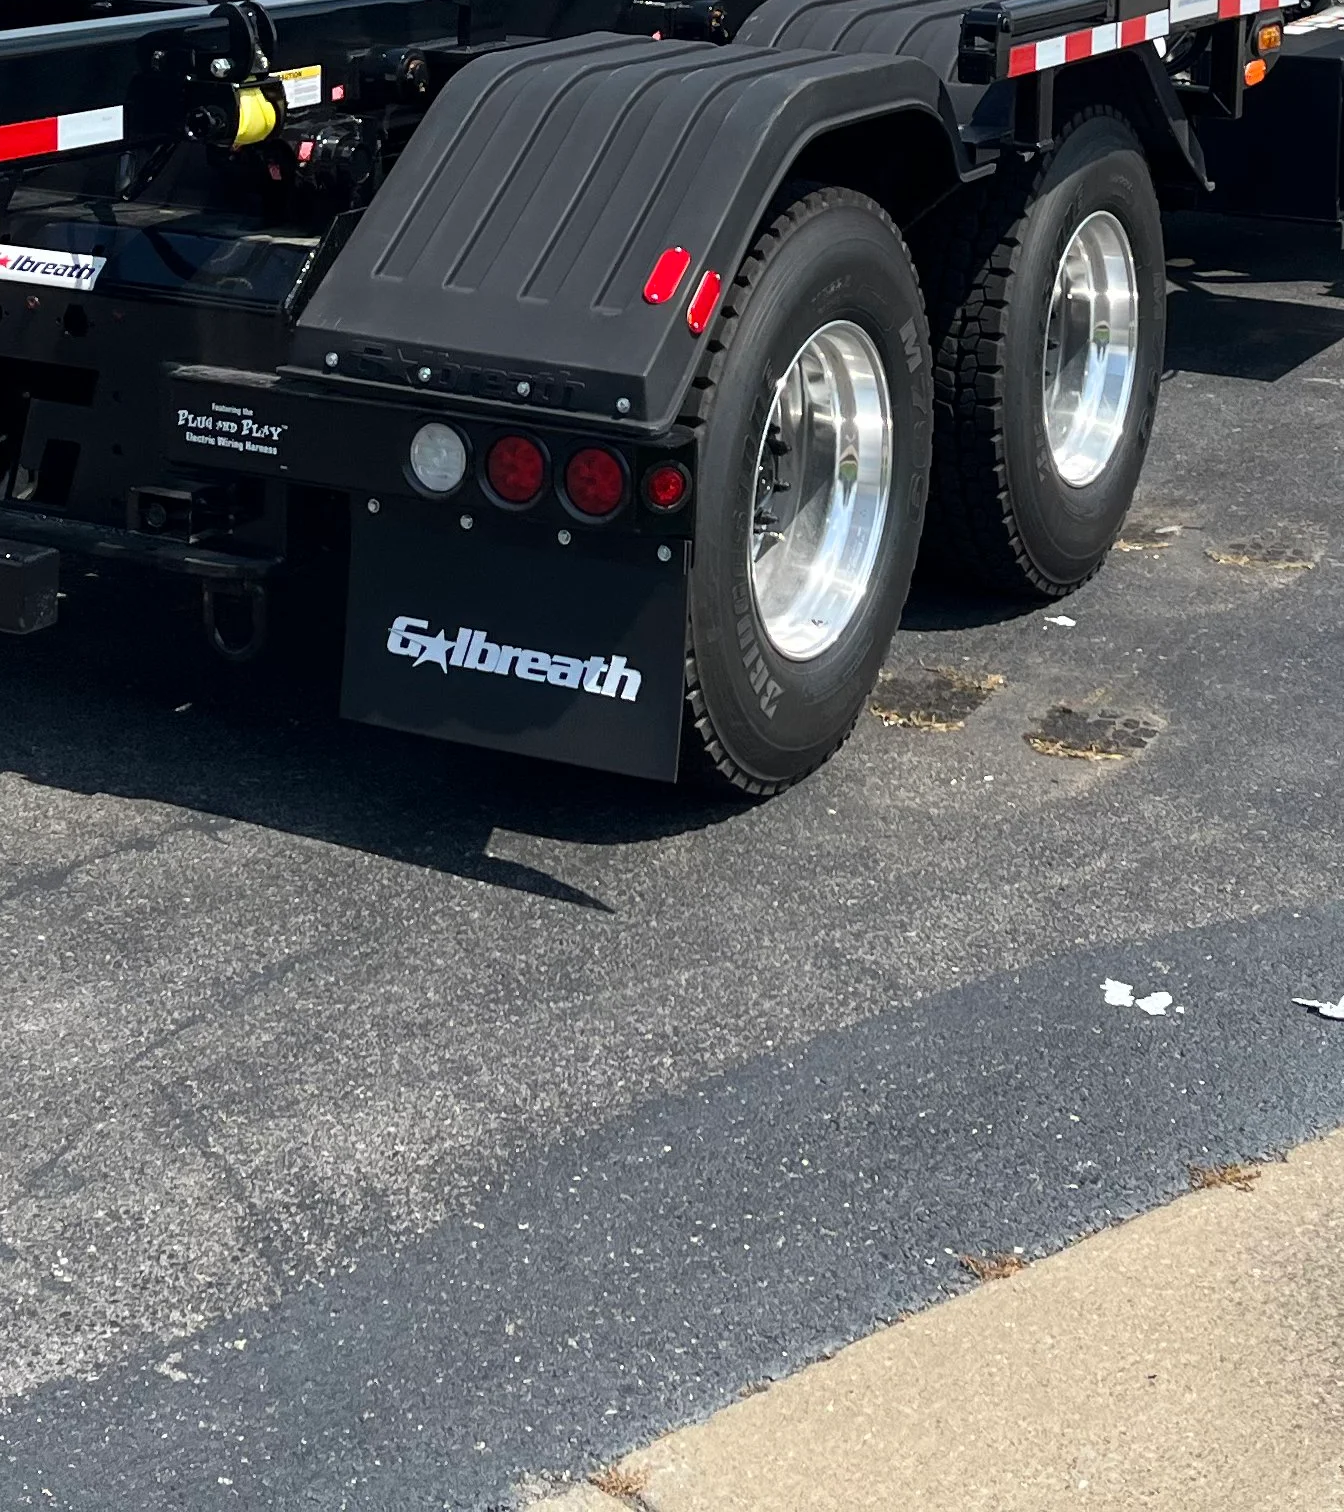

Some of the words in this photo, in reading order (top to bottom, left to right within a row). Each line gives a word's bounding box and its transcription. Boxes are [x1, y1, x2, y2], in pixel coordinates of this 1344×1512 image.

[242, 407, 254, 416] the
[185, 431, 216, 446] Electric
[217, 435, 244, 452] Wiring
[245, 441, 278, 456] Harness
